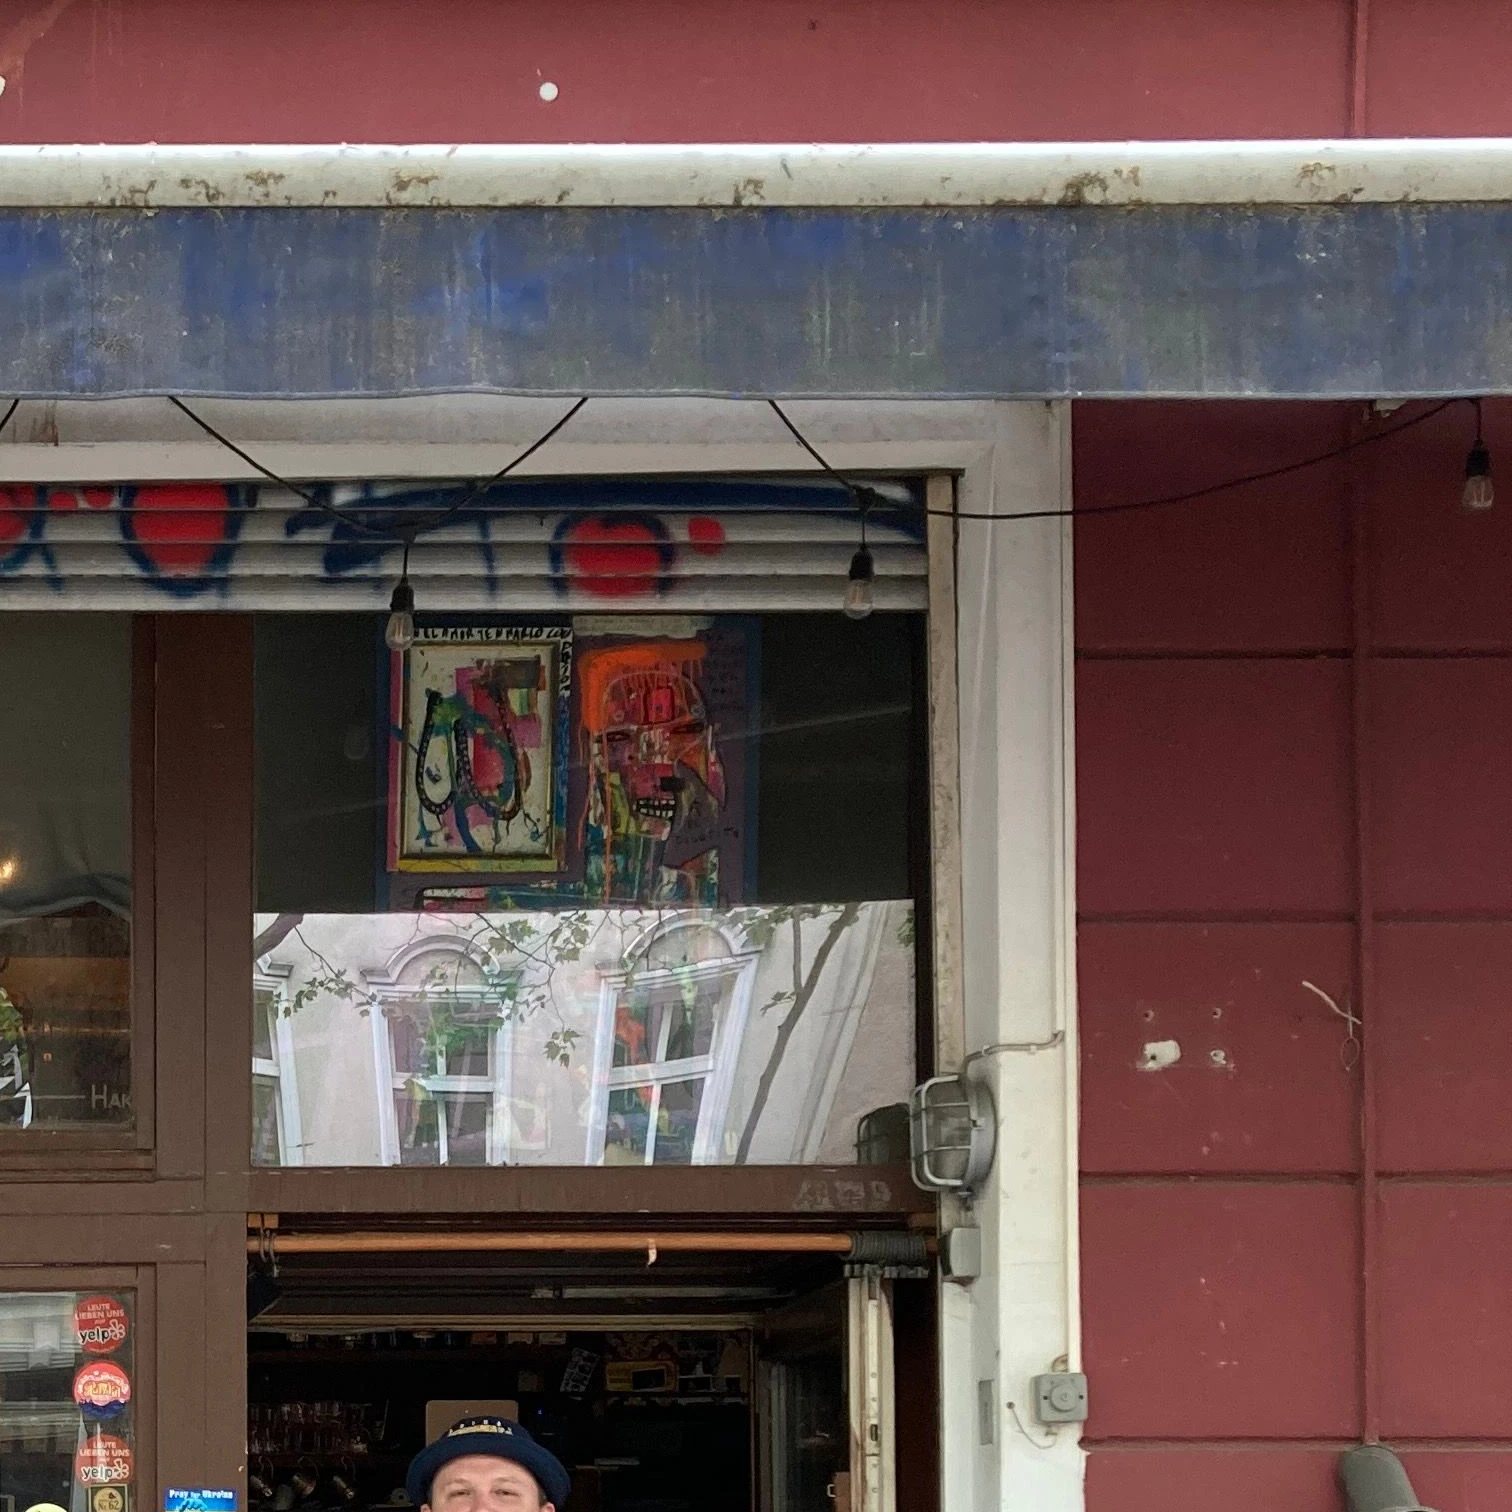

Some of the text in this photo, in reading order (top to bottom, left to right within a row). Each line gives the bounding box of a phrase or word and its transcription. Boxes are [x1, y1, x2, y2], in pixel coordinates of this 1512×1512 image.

[106, 1309, 124, 1318] UNS
[79, 1326, 110, 1344] yelp
[93, 1441, 116, 1449] LEUTE
[111, 1449, 130, 1457] UNS
[81, 1463, 113, 1482] yelp
[169, 1489, 188, 1499] Pray
[201, 1489, 233, 1499] Ukraine
[108, 1501, 120, 1511] 62
